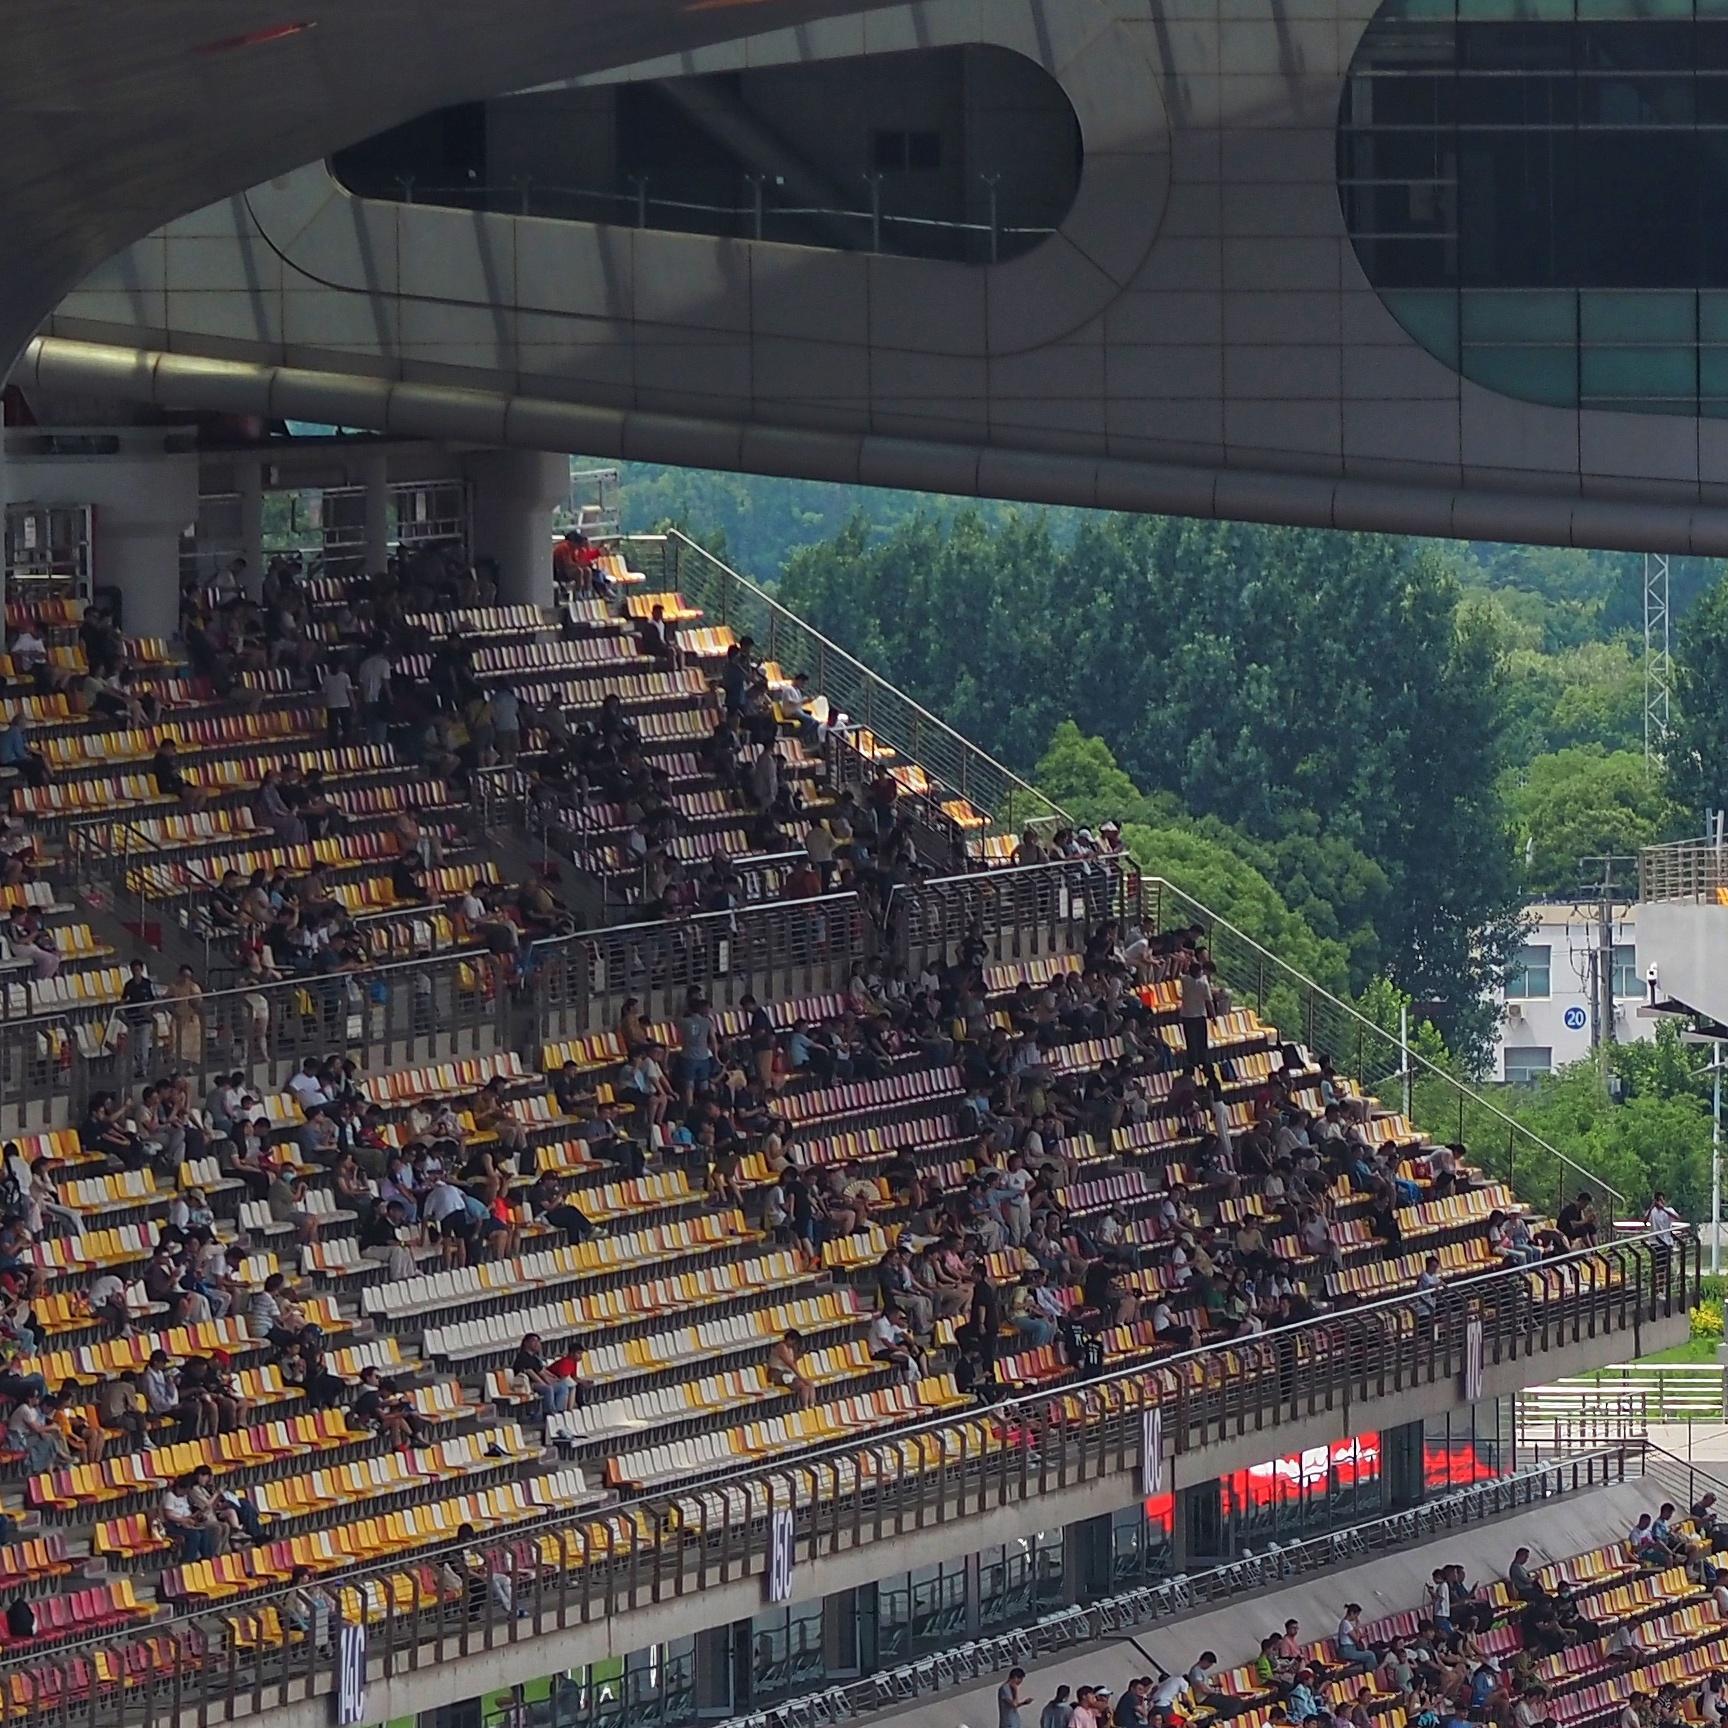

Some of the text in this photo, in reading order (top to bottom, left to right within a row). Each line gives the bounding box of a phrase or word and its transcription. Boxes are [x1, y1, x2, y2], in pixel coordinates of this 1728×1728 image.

[1567, 1011, 1584, 1026] 20
[1144, 1407, 1161, 1493] 16C
[772, 1510, 793, 1601] 15C
[341, 1624, 365, 1725] 14C
